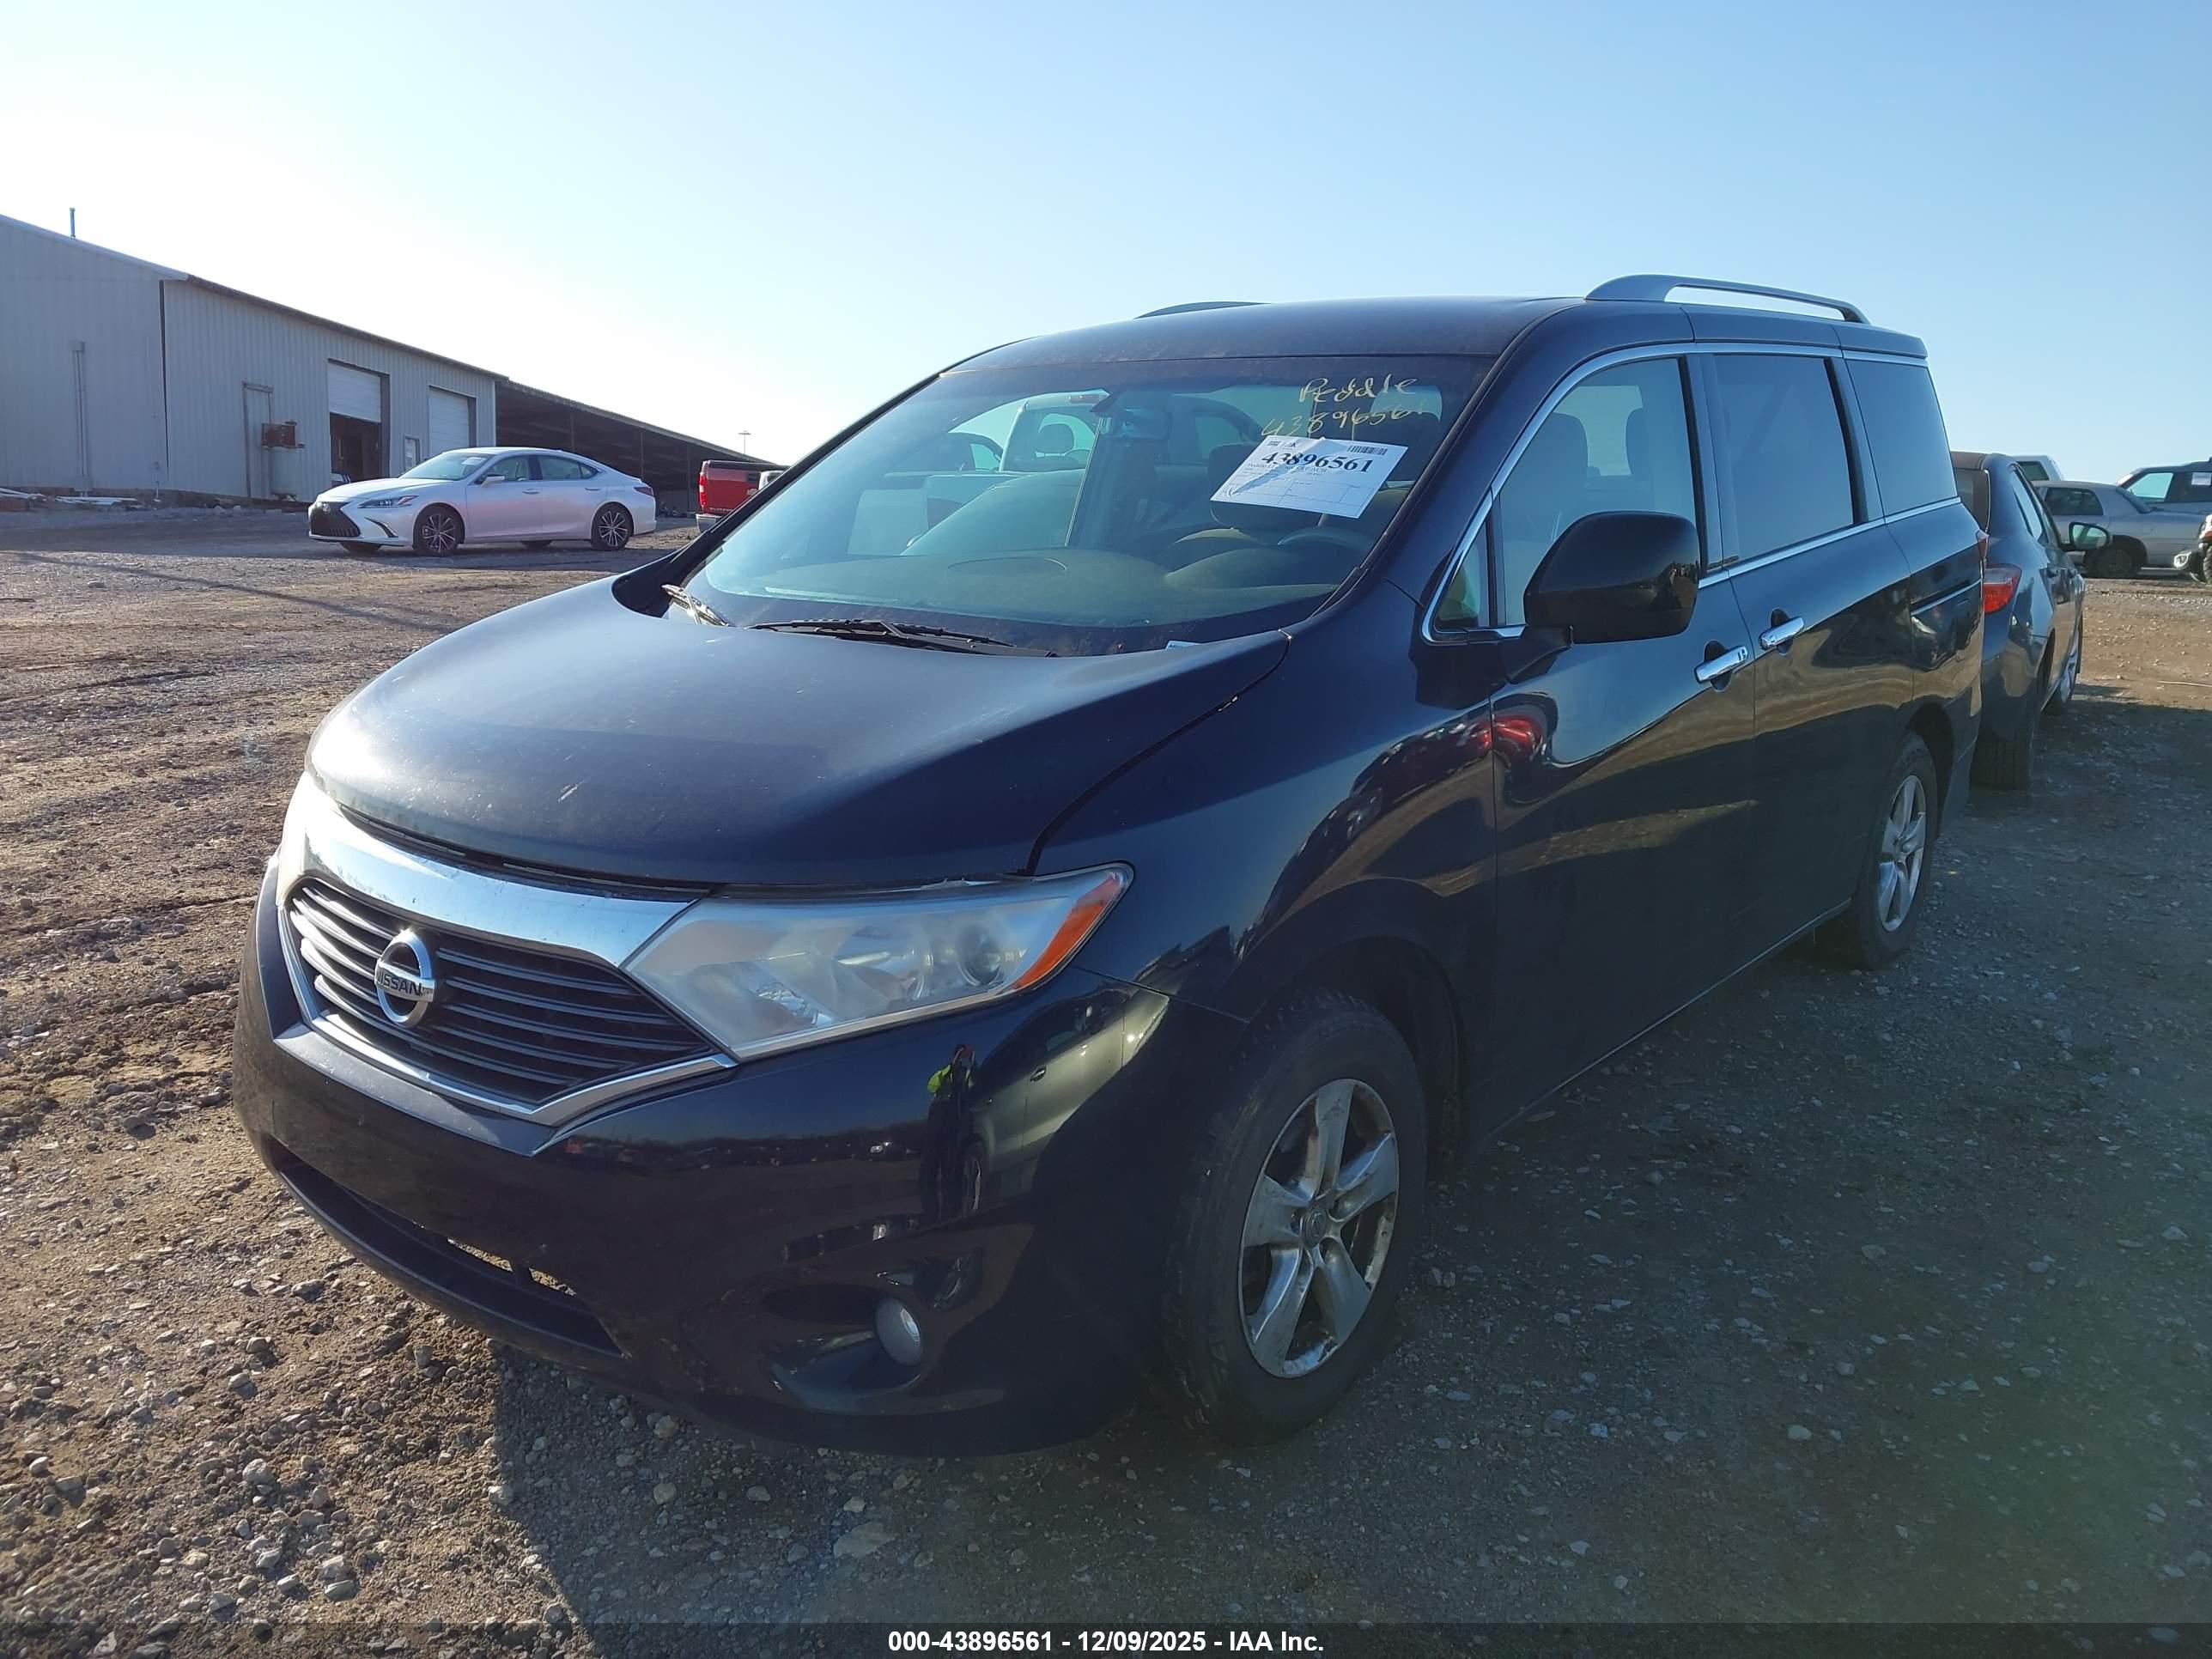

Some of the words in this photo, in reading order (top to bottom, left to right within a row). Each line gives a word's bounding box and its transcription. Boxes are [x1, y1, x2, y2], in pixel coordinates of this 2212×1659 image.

[1299, 374, 1418, 403] Peddle
[1261, 452, 1375, 473] 43896561
[376, 969, 422, 996] NISSAN
